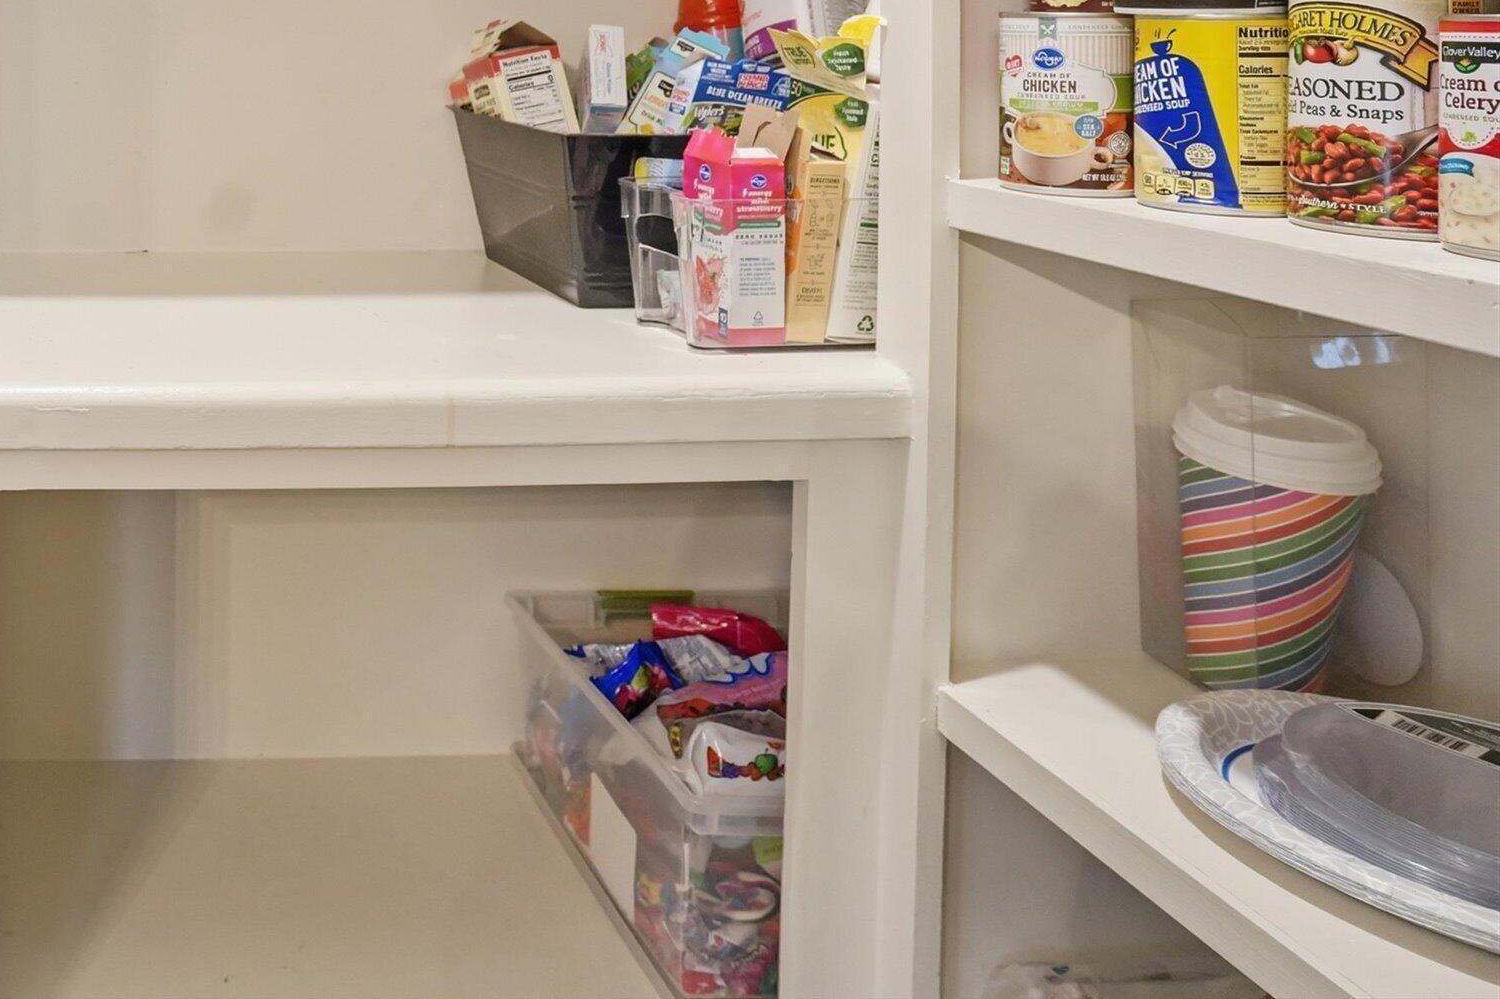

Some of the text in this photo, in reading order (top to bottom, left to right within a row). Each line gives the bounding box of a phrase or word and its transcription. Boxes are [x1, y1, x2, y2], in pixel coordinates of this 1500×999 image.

[1238, 27, 1289, 39] Nutritio
[1328, 13, 1413, 48] HOLMES
[1135, 57, 1180, 82] EAM OF
[1238, 64, 1274, 74] Calories
[548, 74, 554, 83] 0
[508, 81, 535, 92] Calories
[1022, 79, 1077, 93] CHICKEN
[1289, 78, 1405, 102] EASONED
[706, 85, 783, 110] BLUE OCEAN BREEZE
[1166, 98, 1190, 110] SOUP
[1445, 93, 1500, 114] Celery
[1300, 99, 1326, 117] Peas
[1331, 105, 1342, 117] &
[1346, 105, 1405, 125] Snaps
[1347, 203, 1387, 214] STYLE
